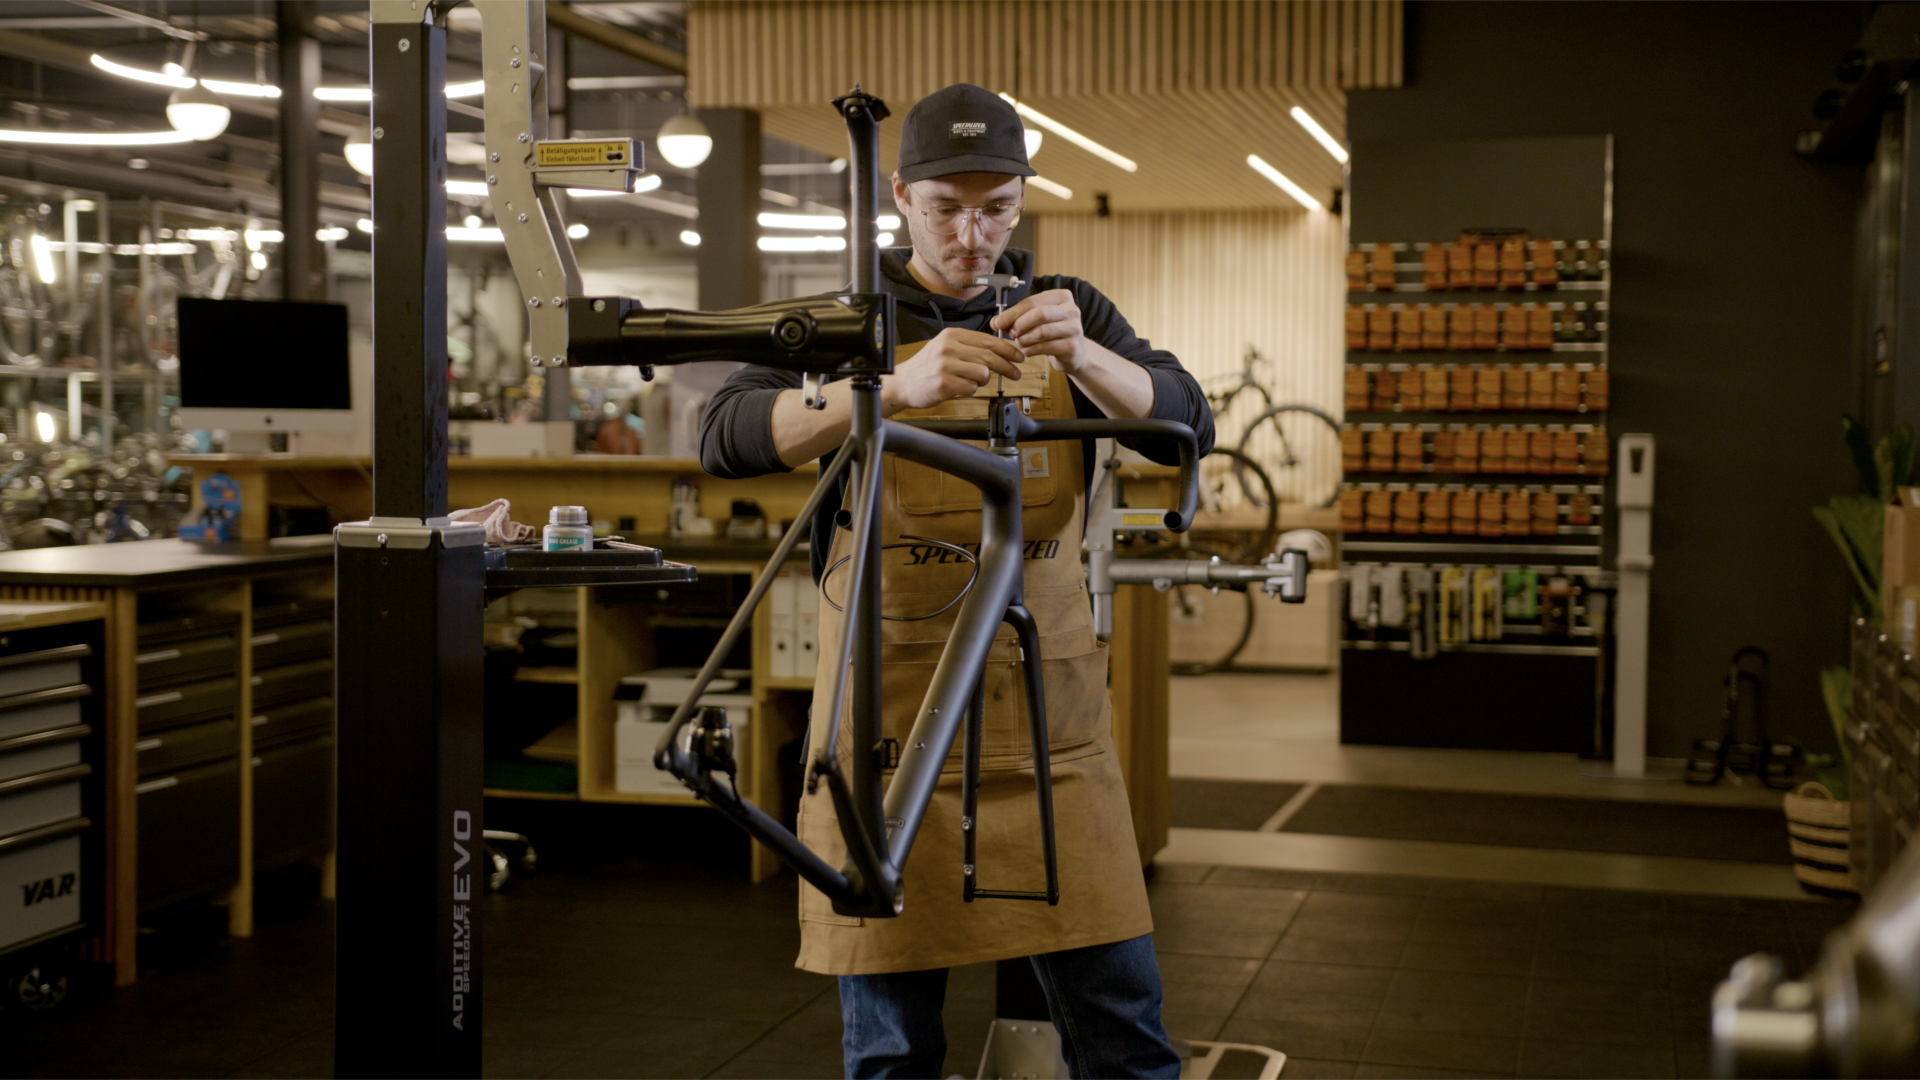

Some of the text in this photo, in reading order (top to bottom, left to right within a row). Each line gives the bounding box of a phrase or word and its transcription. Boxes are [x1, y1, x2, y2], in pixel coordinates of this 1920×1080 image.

[20, 872, 76, 906] VAR
[453, 810, 471, 901] EVO
[452, 904, 464, 1031] ADDITIVE
[463, 904, 471, 993] SPEEDLIFT
